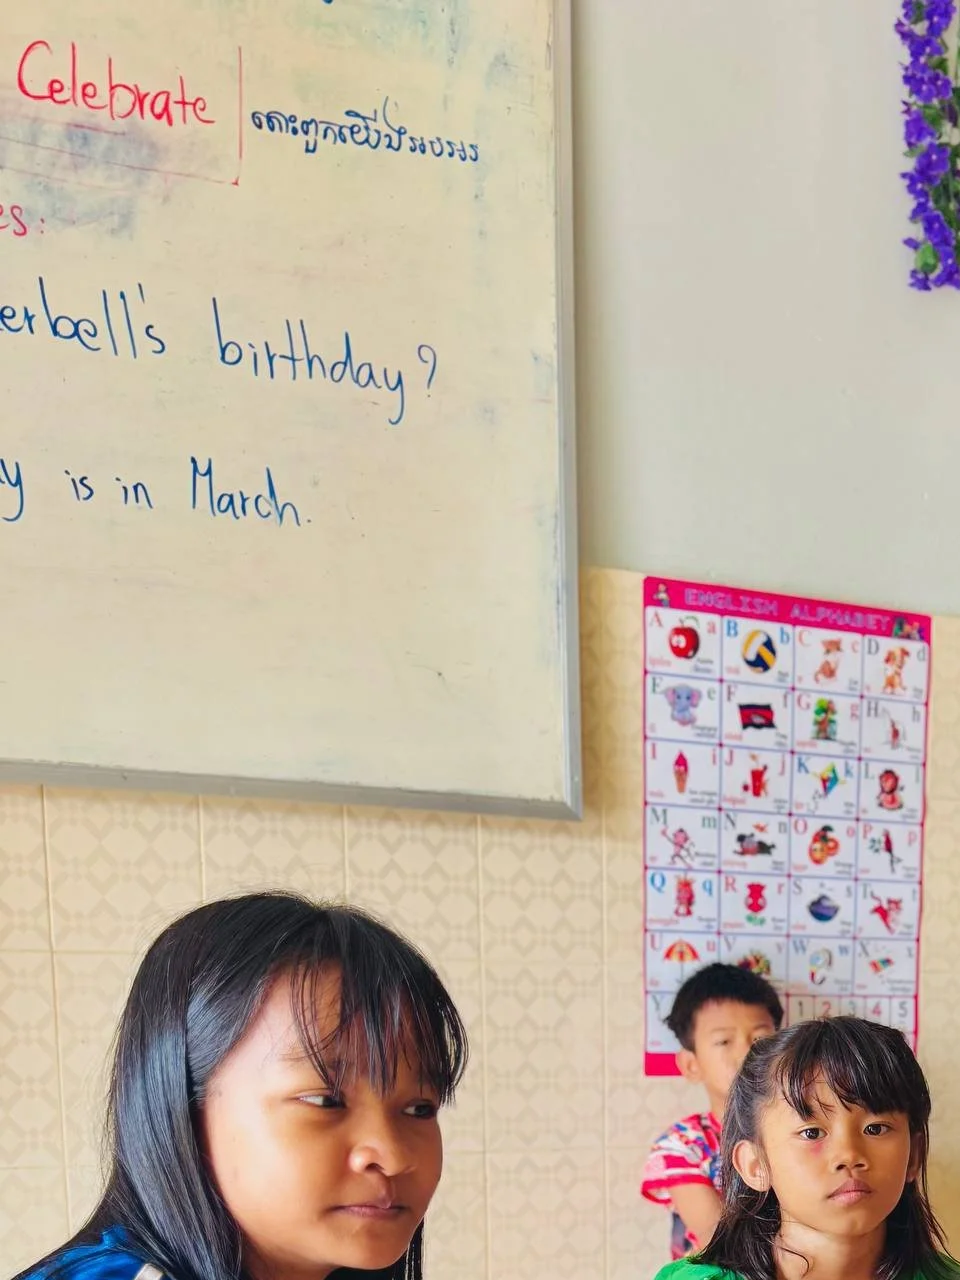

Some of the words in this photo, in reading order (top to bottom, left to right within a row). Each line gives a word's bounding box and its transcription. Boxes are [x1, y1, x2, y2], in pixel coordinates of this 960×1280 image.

[17, 40, 216, 127] Celebrate
[0, 203, 45, 237] s:
[212, 296, 437, 425] birthday?
[0, 457, 24, 522] y
[65, 469, 94, 502] is
[116, 477, 153, 509] in
[190, 456, 312, 527] March.
[684, 588, 779, 617] ENGLISH
[790, 603, 891, 631] ALPHABET
[650, 611, 663, 627] A
[727, 619, 738, 637] B
[798, 630, 811, 647] C
[867, 638, 880, 655] D
[651, 677, 664, 694] E
[727, 684, 737, 702] F
[797, 693, 810, 710] G
[867, 700, 878, 718] H
[725, 749, 733, 766] J
[797, 757, 810, 774] K
[864, 762, 875, 779] L
[650, 807, 667, 825] M
[725, 812, 737, 830] N
[794, 818, 807, 835] O
[863, 823, 873, 839] P
[650, 871, 666, 893] Q
[725, 876, 737, 893] R
[793, 879, 803, 895] S
[861, 882, 871, 899] T
[650, 933, 662, 950] U
[724, 935, 736, 951] V
[792, 938, 809, 954] W
[858, 940, 870, 957] X
[798, 1000, 804, 1016] 1
[822, 1001, 832, 1017] 2
[871, 1001, 881, 1016] 4
[898, 1001, 908, 1018] 5
